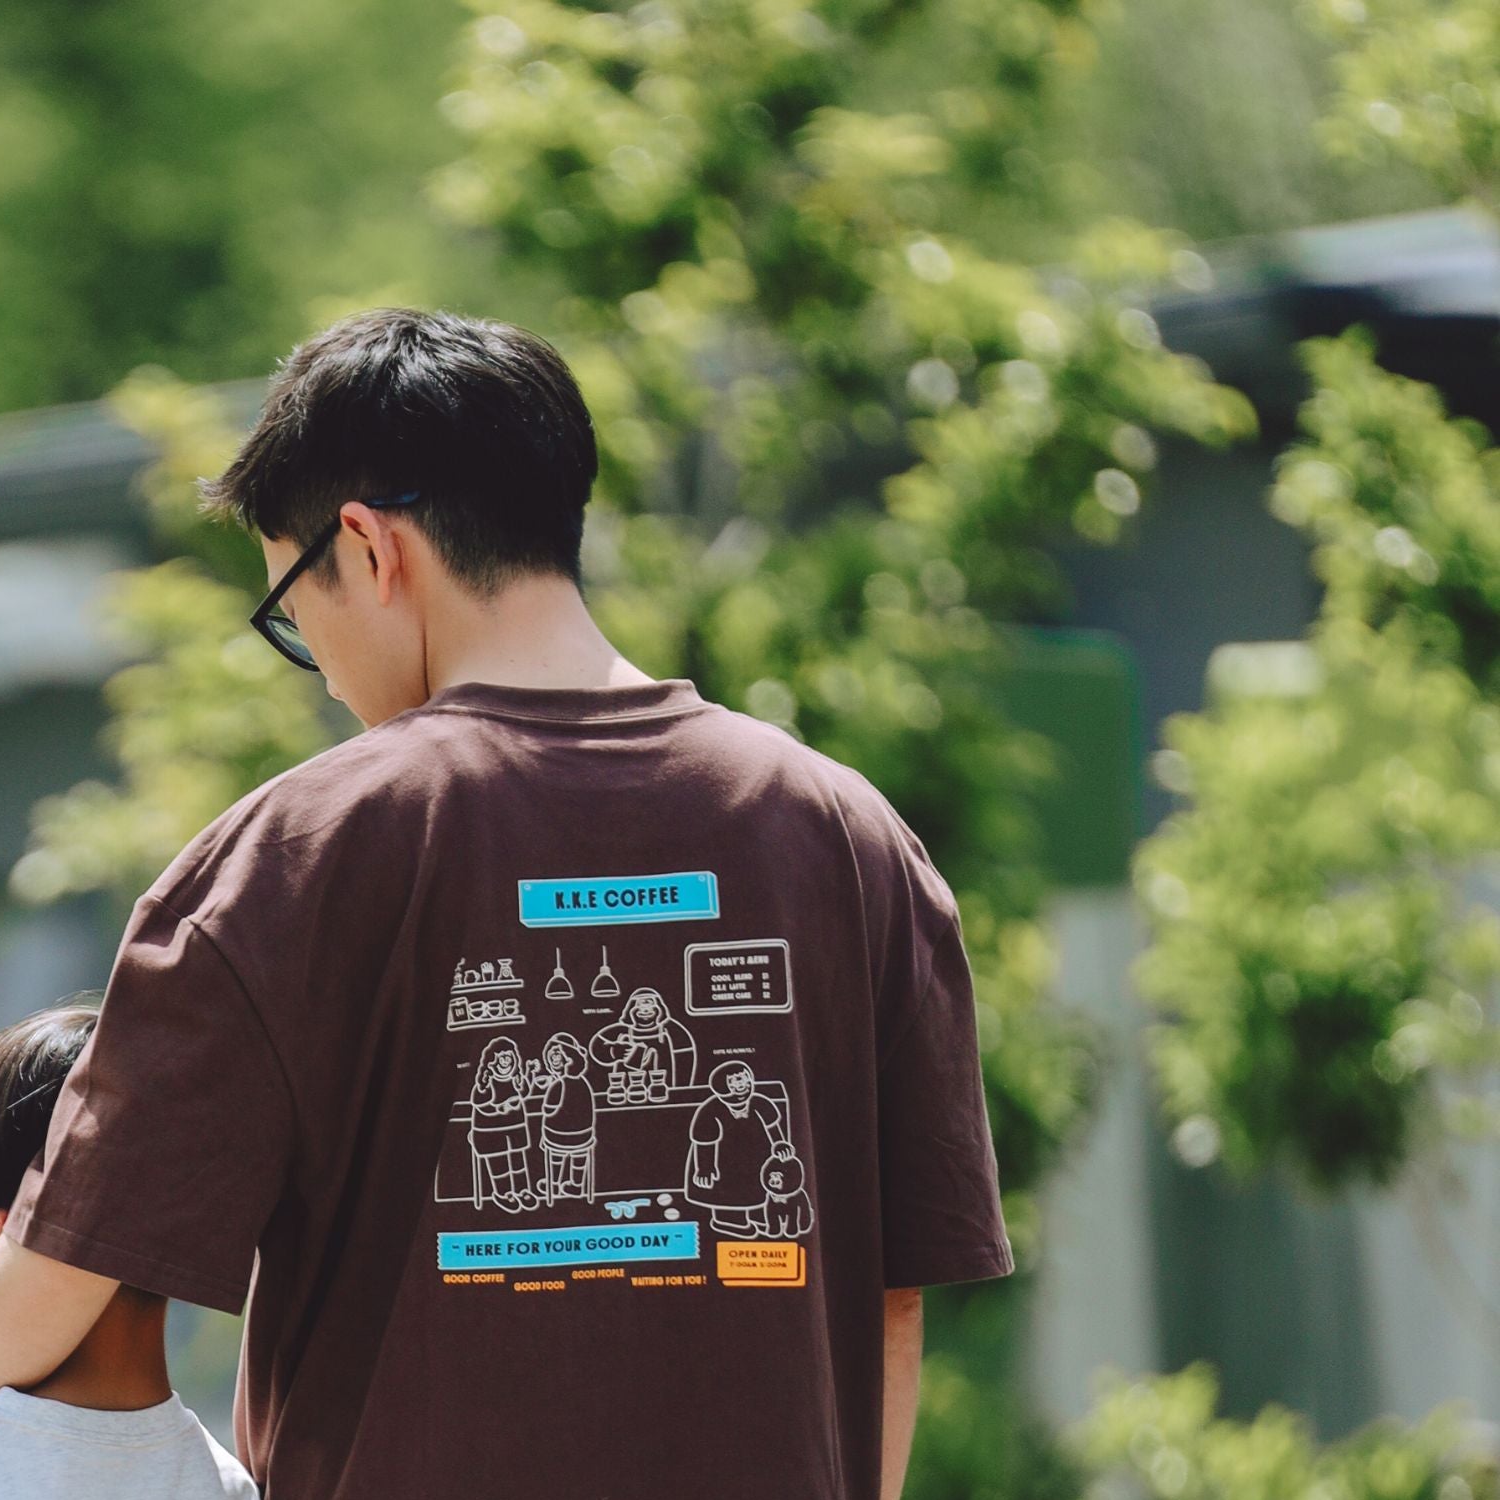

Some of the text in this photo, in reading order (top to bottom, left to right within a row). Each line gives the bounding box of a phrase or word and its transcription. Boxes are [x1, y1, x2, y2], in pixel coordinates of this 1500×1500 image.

[555, 886, 680, 909] K.K.E COFFEE
[465, 1234, 670, 1257] HERE FOR YOUR GOOD DAY
[728, 1250, 788, 1258] OPEN DAILY
[443, 1273, 505, 1284] GOOD COFFEE
[571, 1269, 597, 1279] GOOD
[513, 1281, 566, 1292] GOOD FOOD
[665, 1276, 683, 1286] FOR
